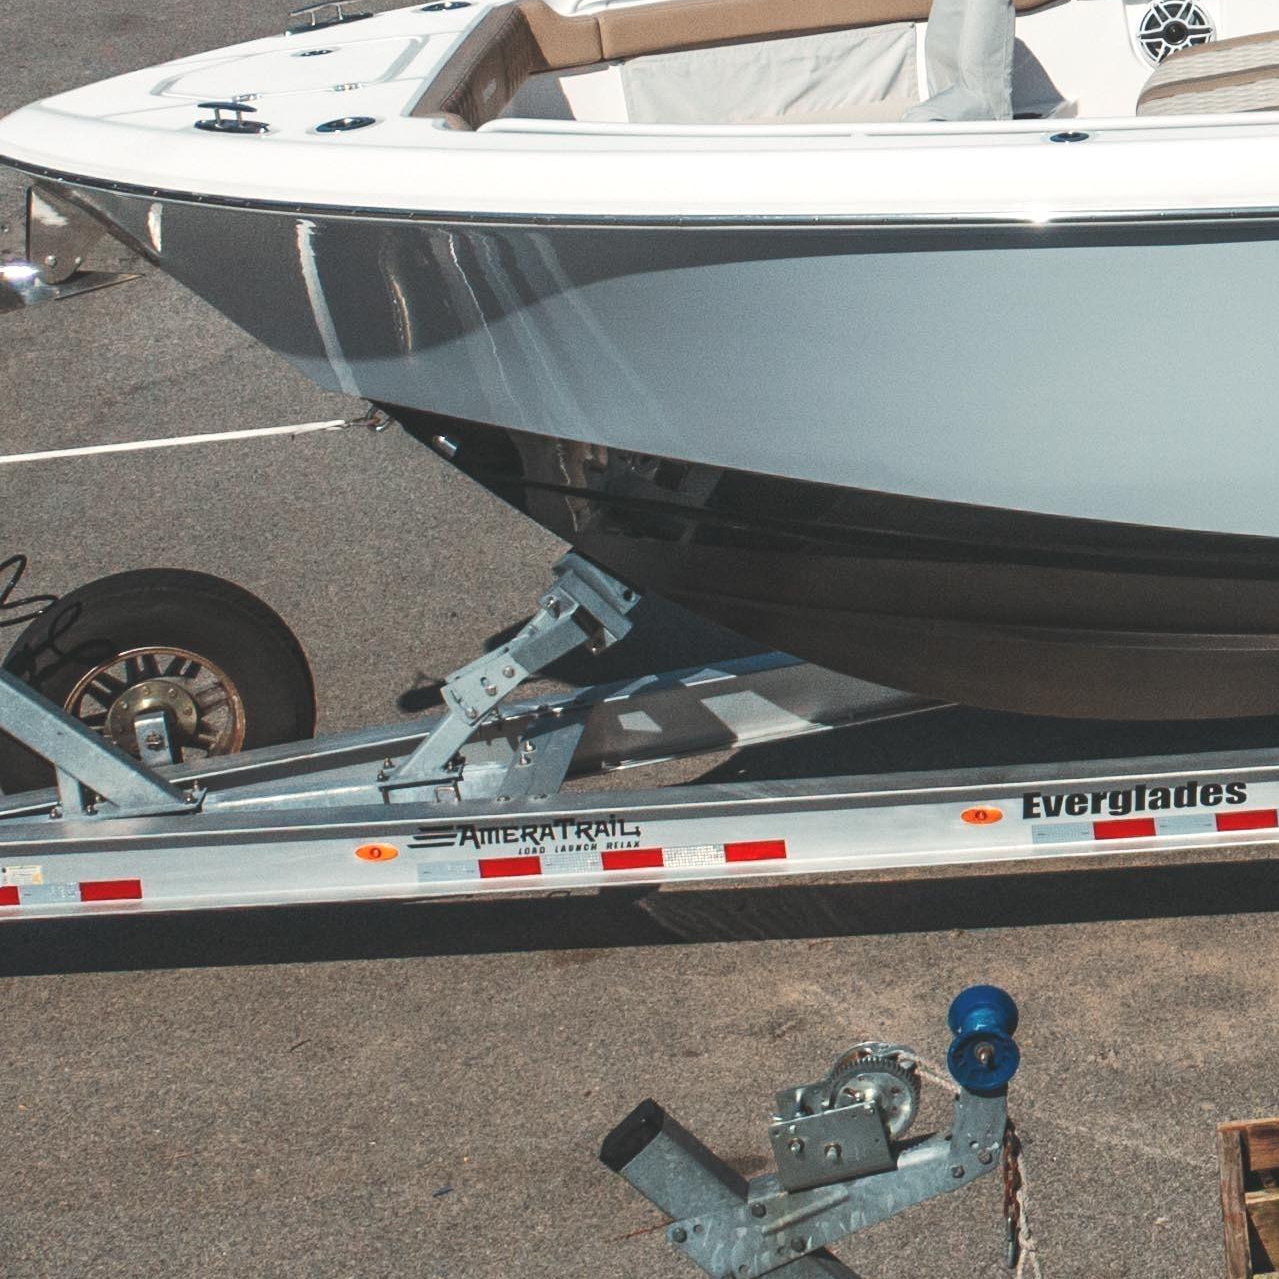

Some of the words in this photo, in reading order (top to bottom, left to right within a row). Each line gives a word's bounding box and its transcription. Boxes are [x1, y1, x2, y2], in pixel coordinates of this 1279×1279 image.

[1022, 781, 1248, 820] Everglades
[518, 845, 546, 856] LOAD
[555, 843, 598, 853] LAUNCH
[606, 840, 640, 850] RELAX
